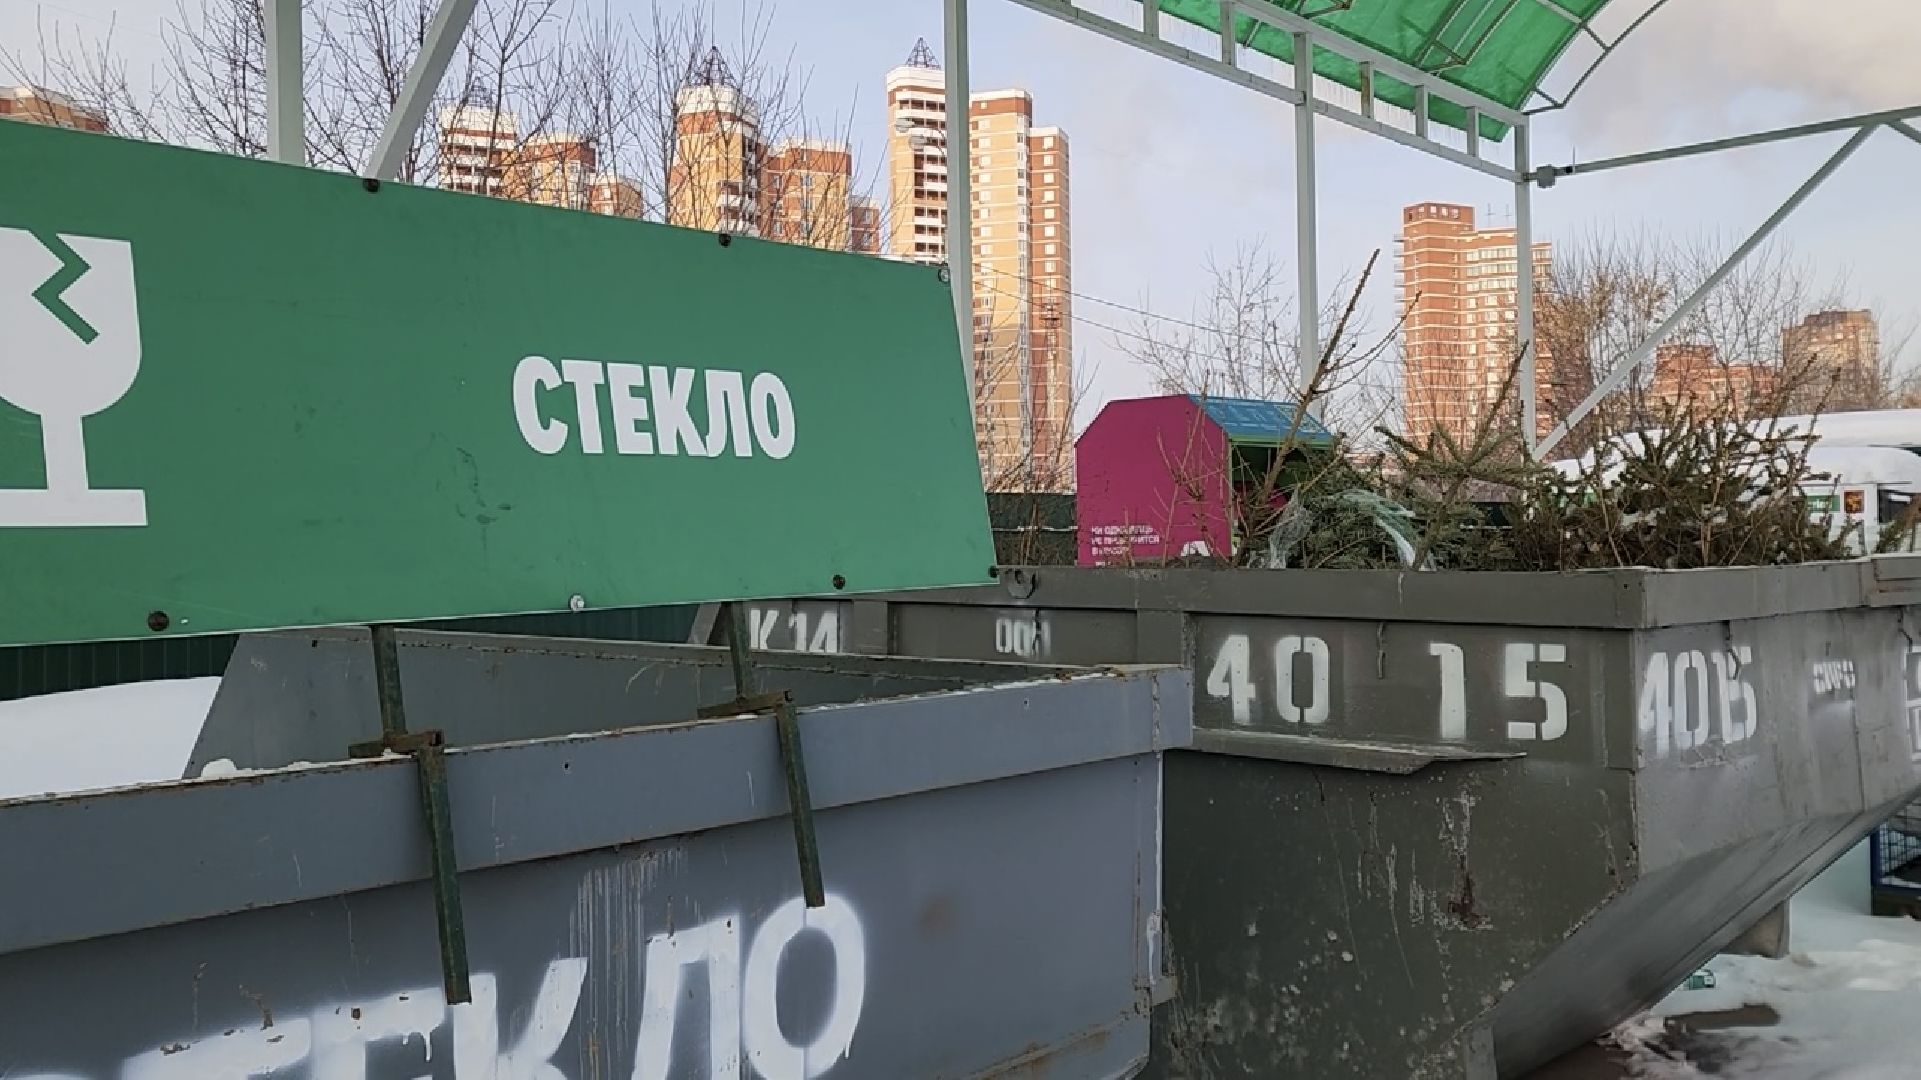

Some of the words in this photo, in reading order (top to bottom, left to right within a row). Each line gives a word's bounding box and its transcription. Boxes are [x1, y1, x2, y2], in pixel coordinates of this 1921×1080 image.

[513, 356, 796, 459] СТЕКЛО
[788, 610, 839, 654] 14
[0, 893, 865, 1080] КЛО
